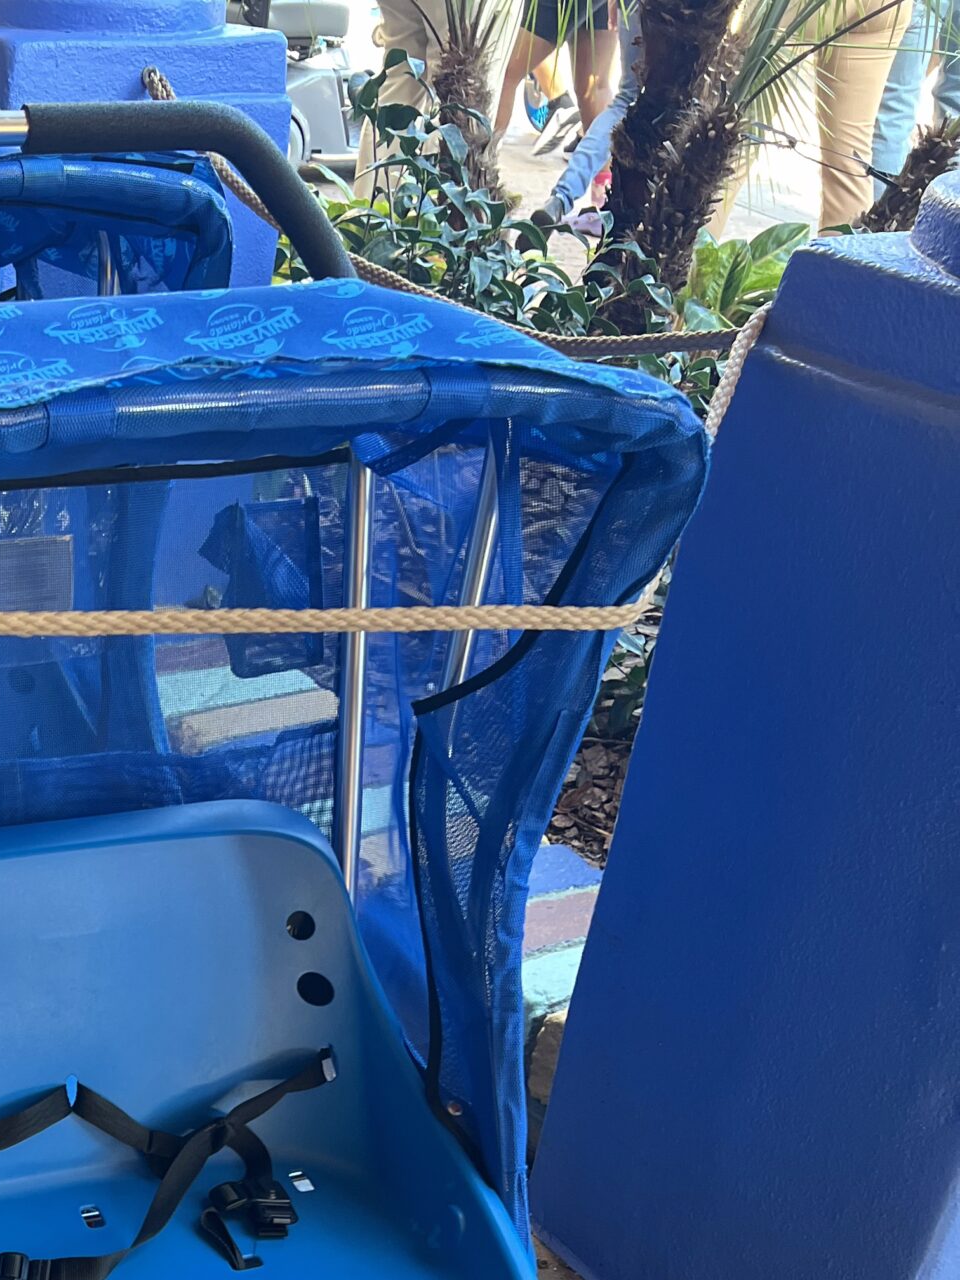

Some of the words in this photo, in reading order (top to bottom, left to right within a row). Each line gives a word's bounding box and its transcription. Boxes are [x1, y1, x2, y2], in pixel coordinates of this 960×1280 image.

[58, 311, 165, 345] UNIVERSAL
[198, 308, 302, 352] UNIVERSAL
[337, 315, 435, 351] UNIVERSAL
